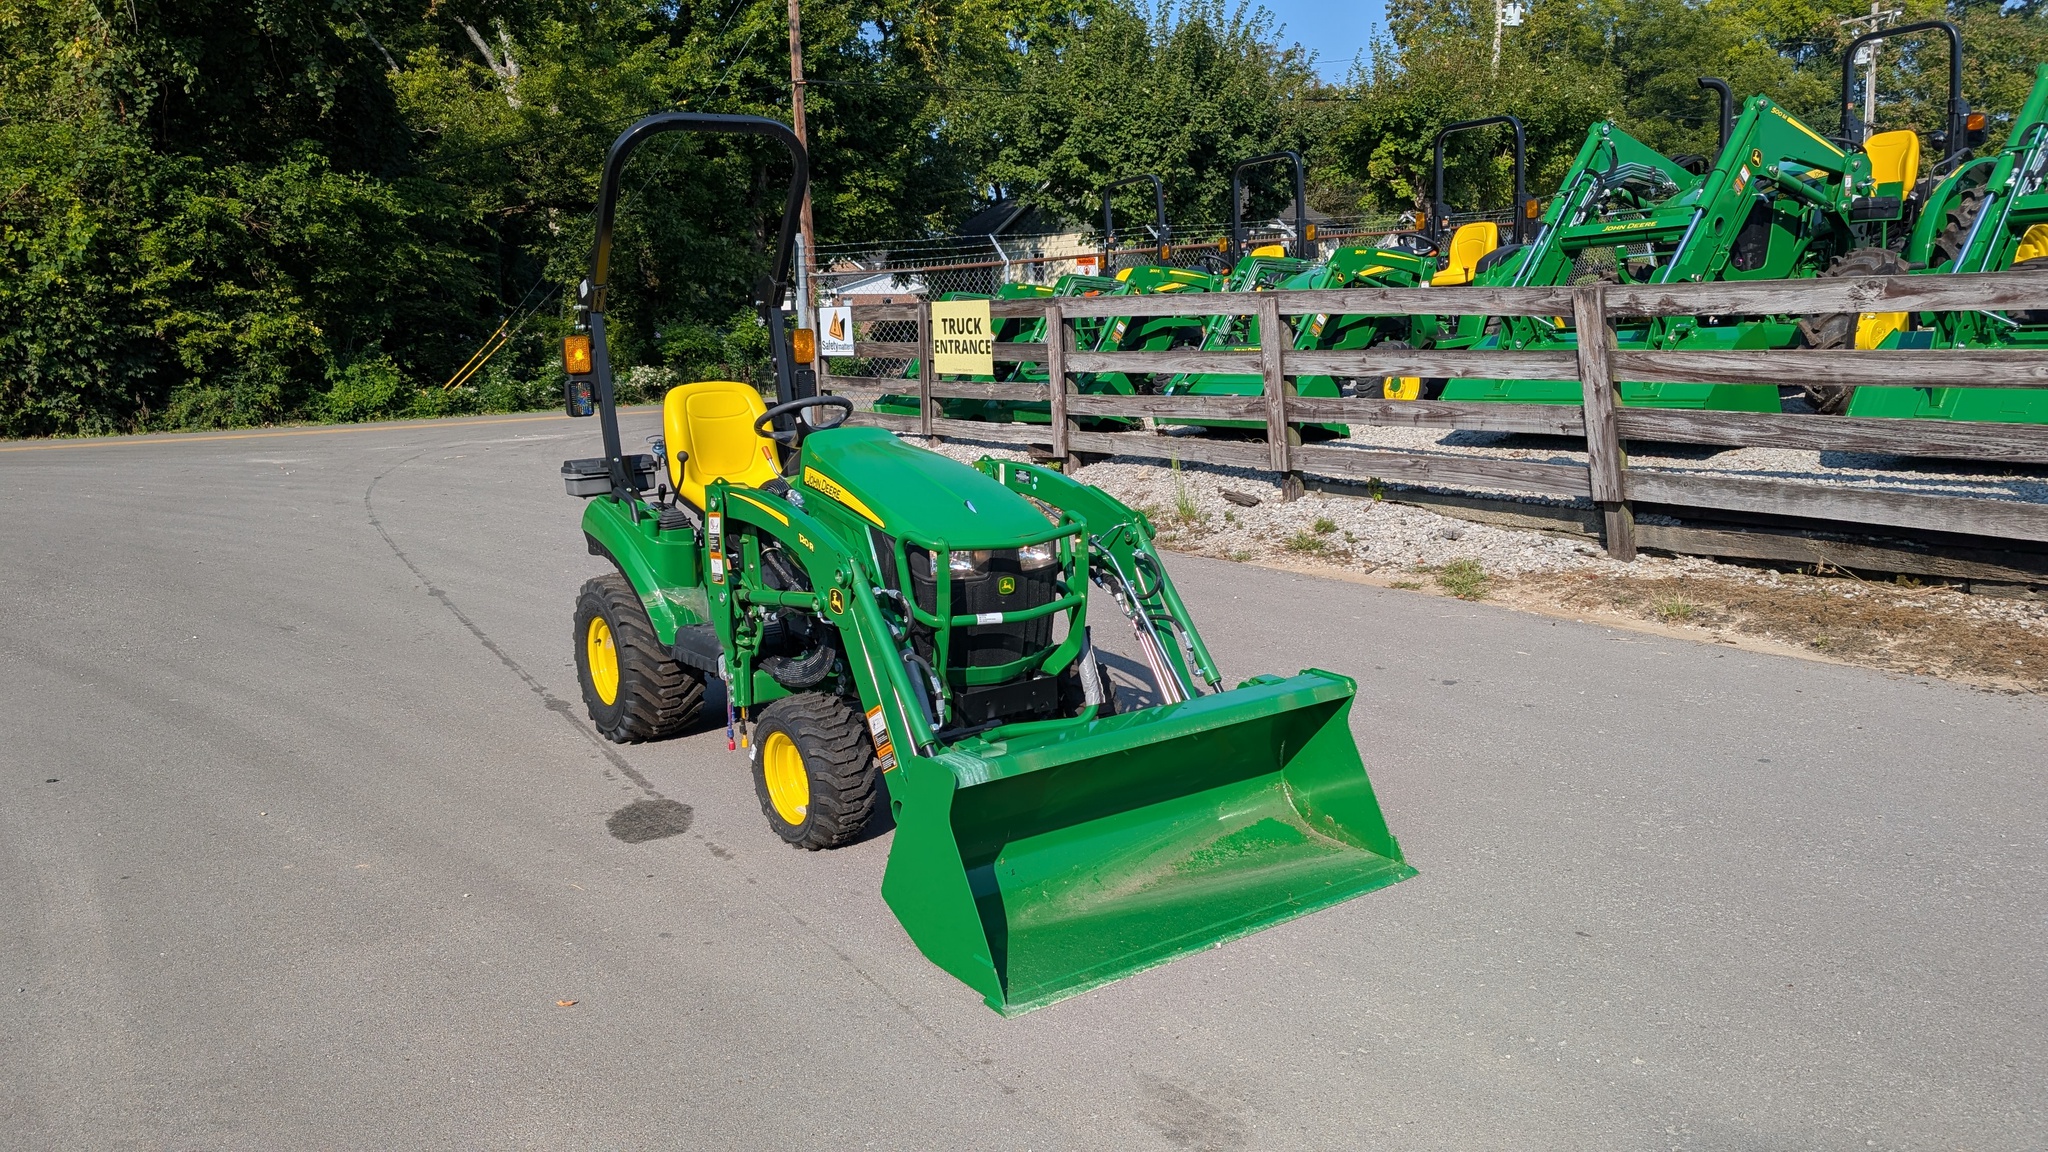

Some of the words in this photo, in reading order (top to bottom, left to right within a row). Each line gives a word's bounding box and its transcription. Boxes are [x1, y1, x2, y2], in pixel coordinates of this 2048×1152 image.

[1601, 224, 1626, 232] JOHN
[1627, 220, 1658, 230] DEERE
[941, 317, 982, 335] TRUCK
[934, 339, 991, 355] ENTRANCE
[805, 473, 821, 490] JOHN
[821, 479, 842, 500] DEERE
